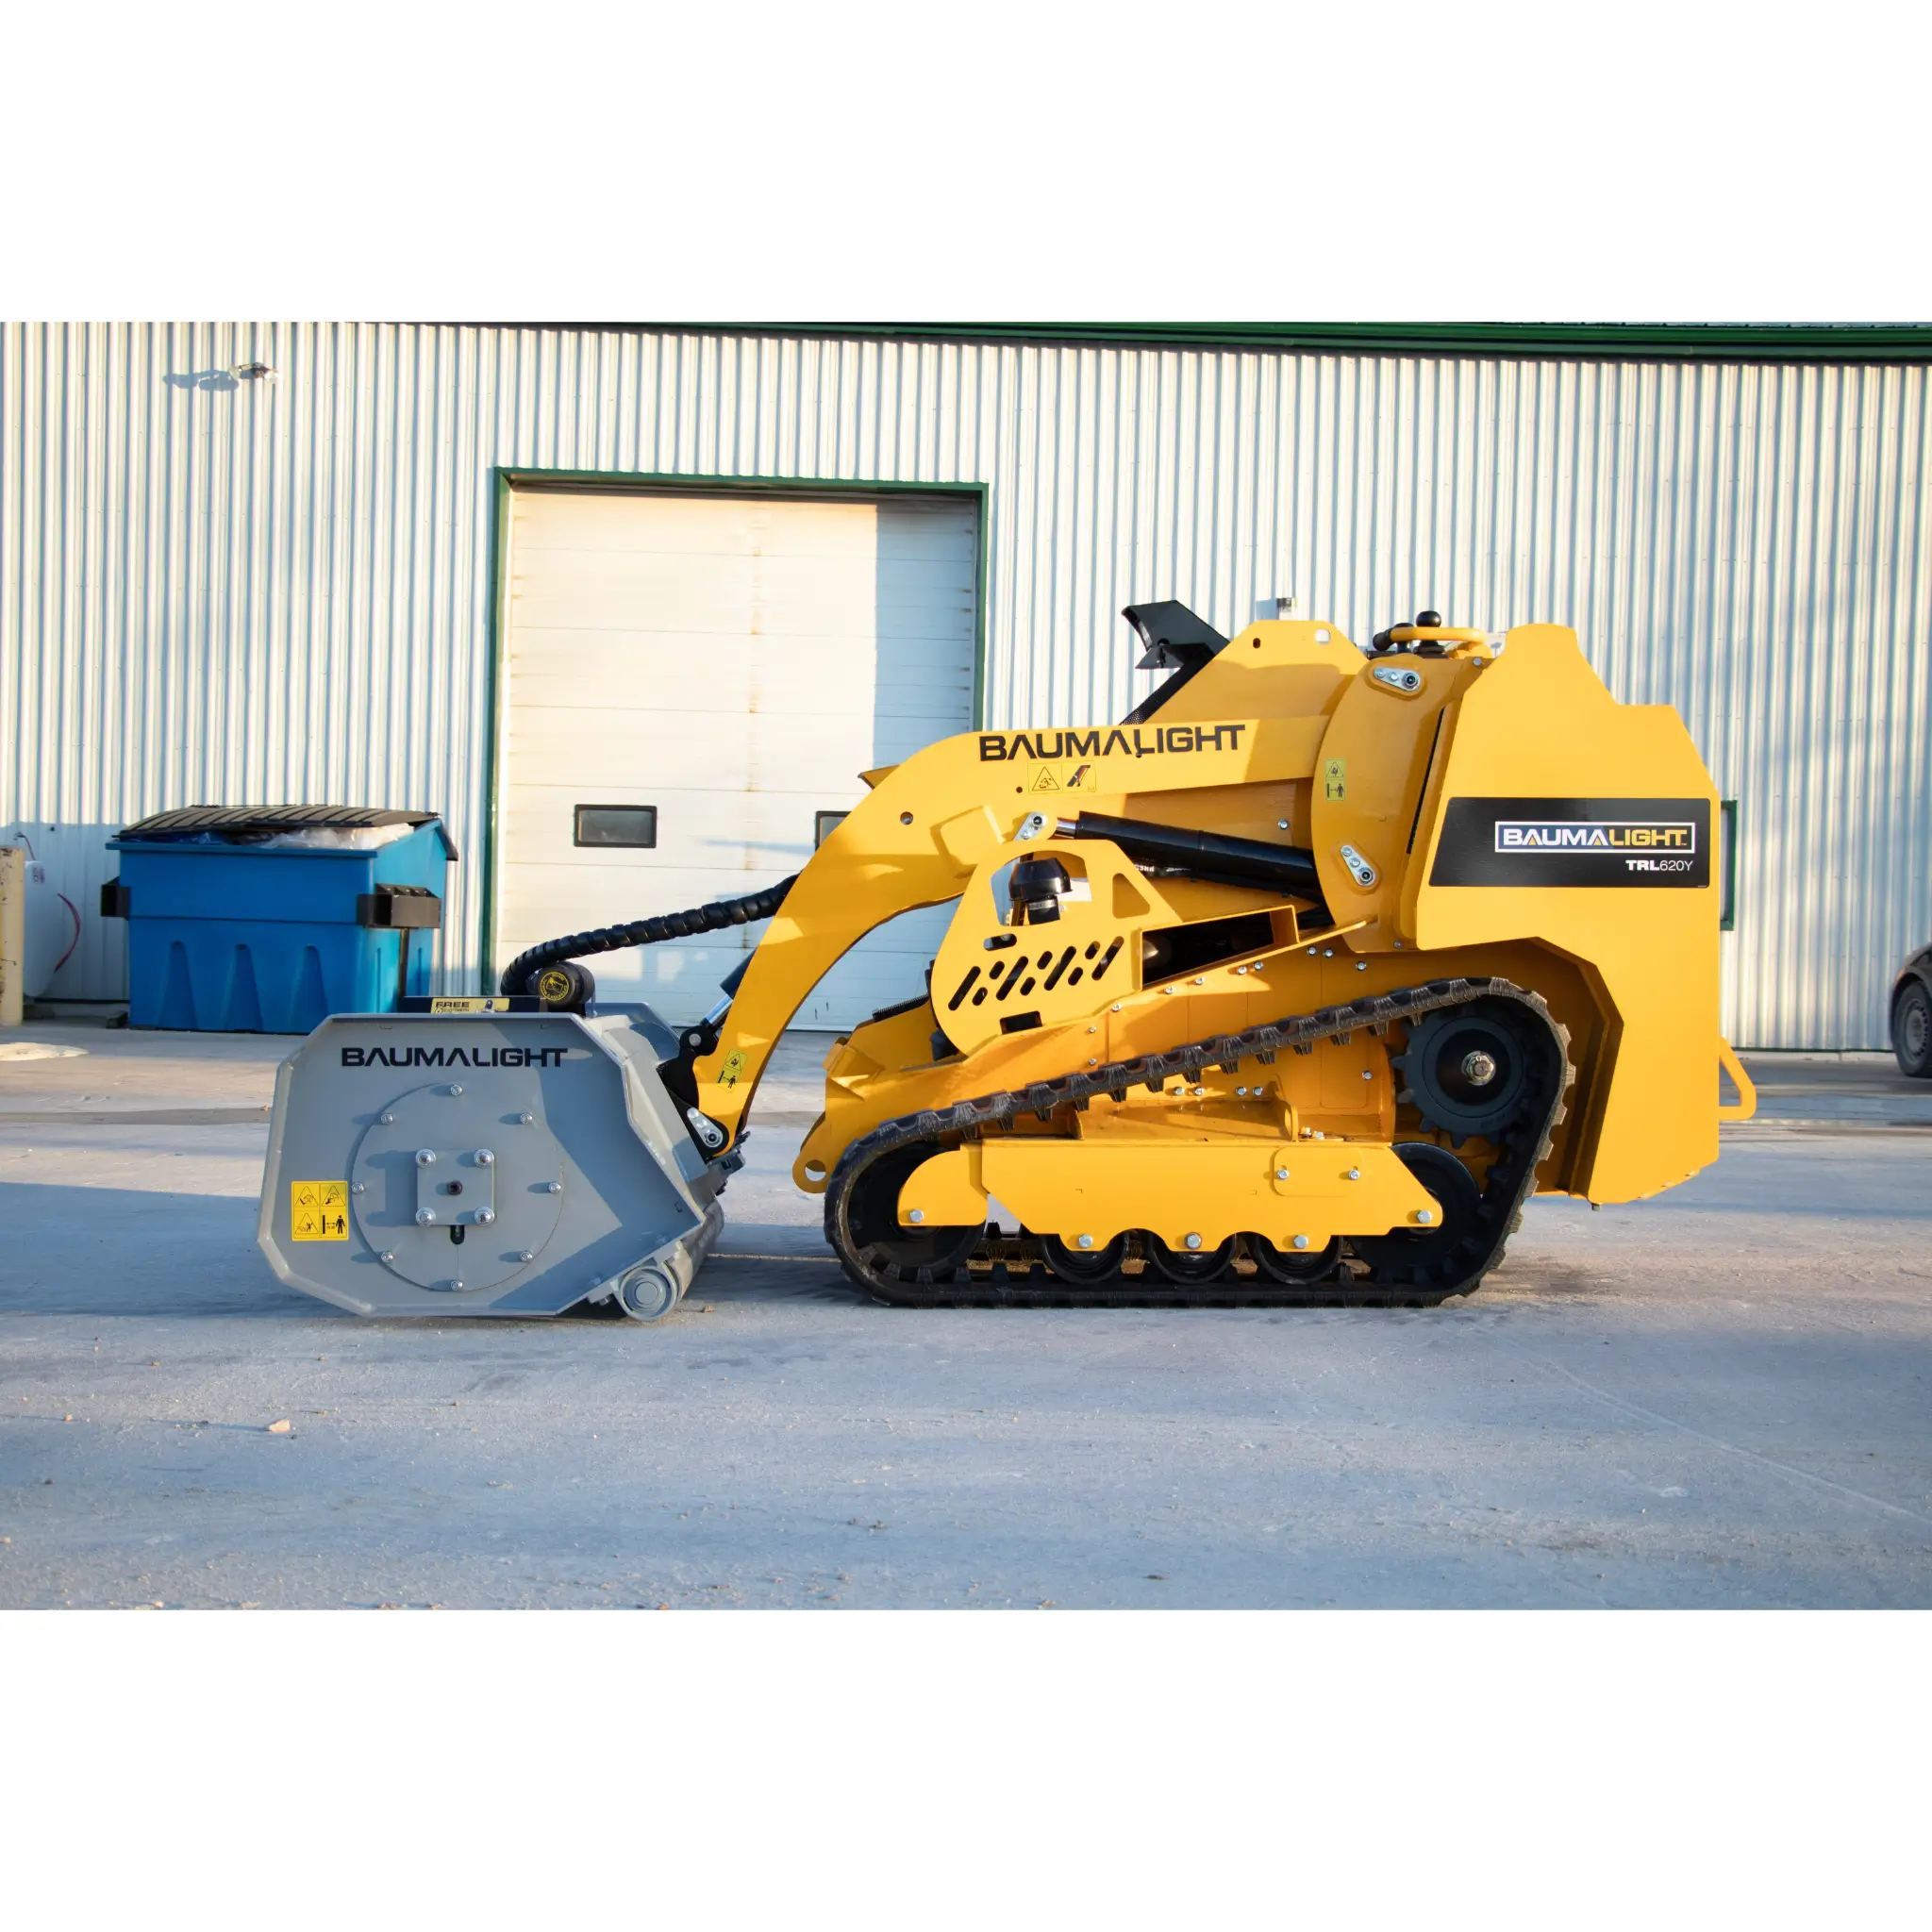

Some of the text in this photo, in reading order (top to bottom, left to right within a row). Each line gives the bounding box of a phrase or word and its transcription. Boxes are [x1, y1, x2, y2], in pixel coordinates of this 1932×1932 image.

[978, 724, 1246, 762] BAUMALIGHT
[1503, 828, 1688, 846] BAUMALIGHT
[1625, 859, 1693, 872] TRL620Y
[341, 1047, 568, 1067] BAUMALIGHT
